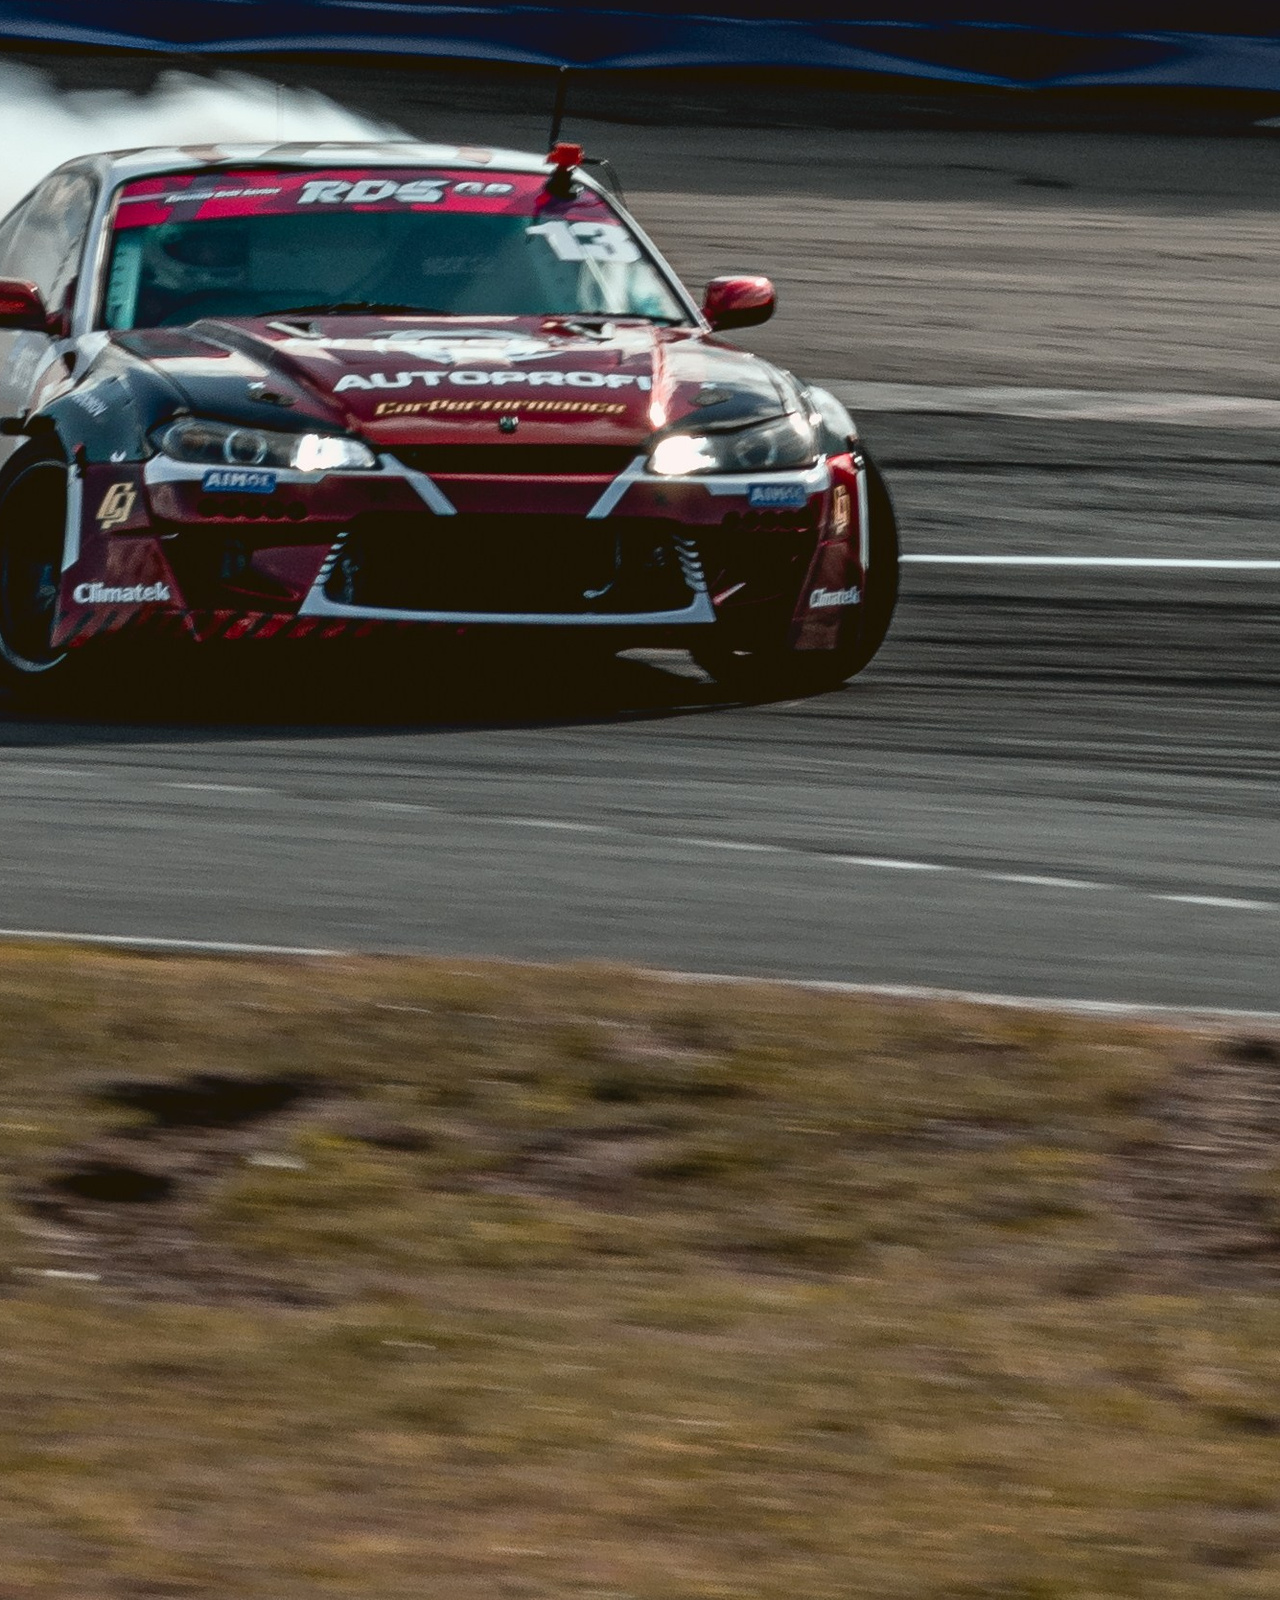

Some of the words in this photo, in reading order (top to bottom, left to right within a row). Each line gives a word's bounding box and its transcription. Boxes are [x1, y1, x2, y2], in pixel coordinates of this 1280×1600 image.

[297, 179, 452, 204] RDS
[525, 220, 642, 264] 13
[333, 370, 652, 392] AUTOPROFI
[73, 581, 172, 604] Climatek
